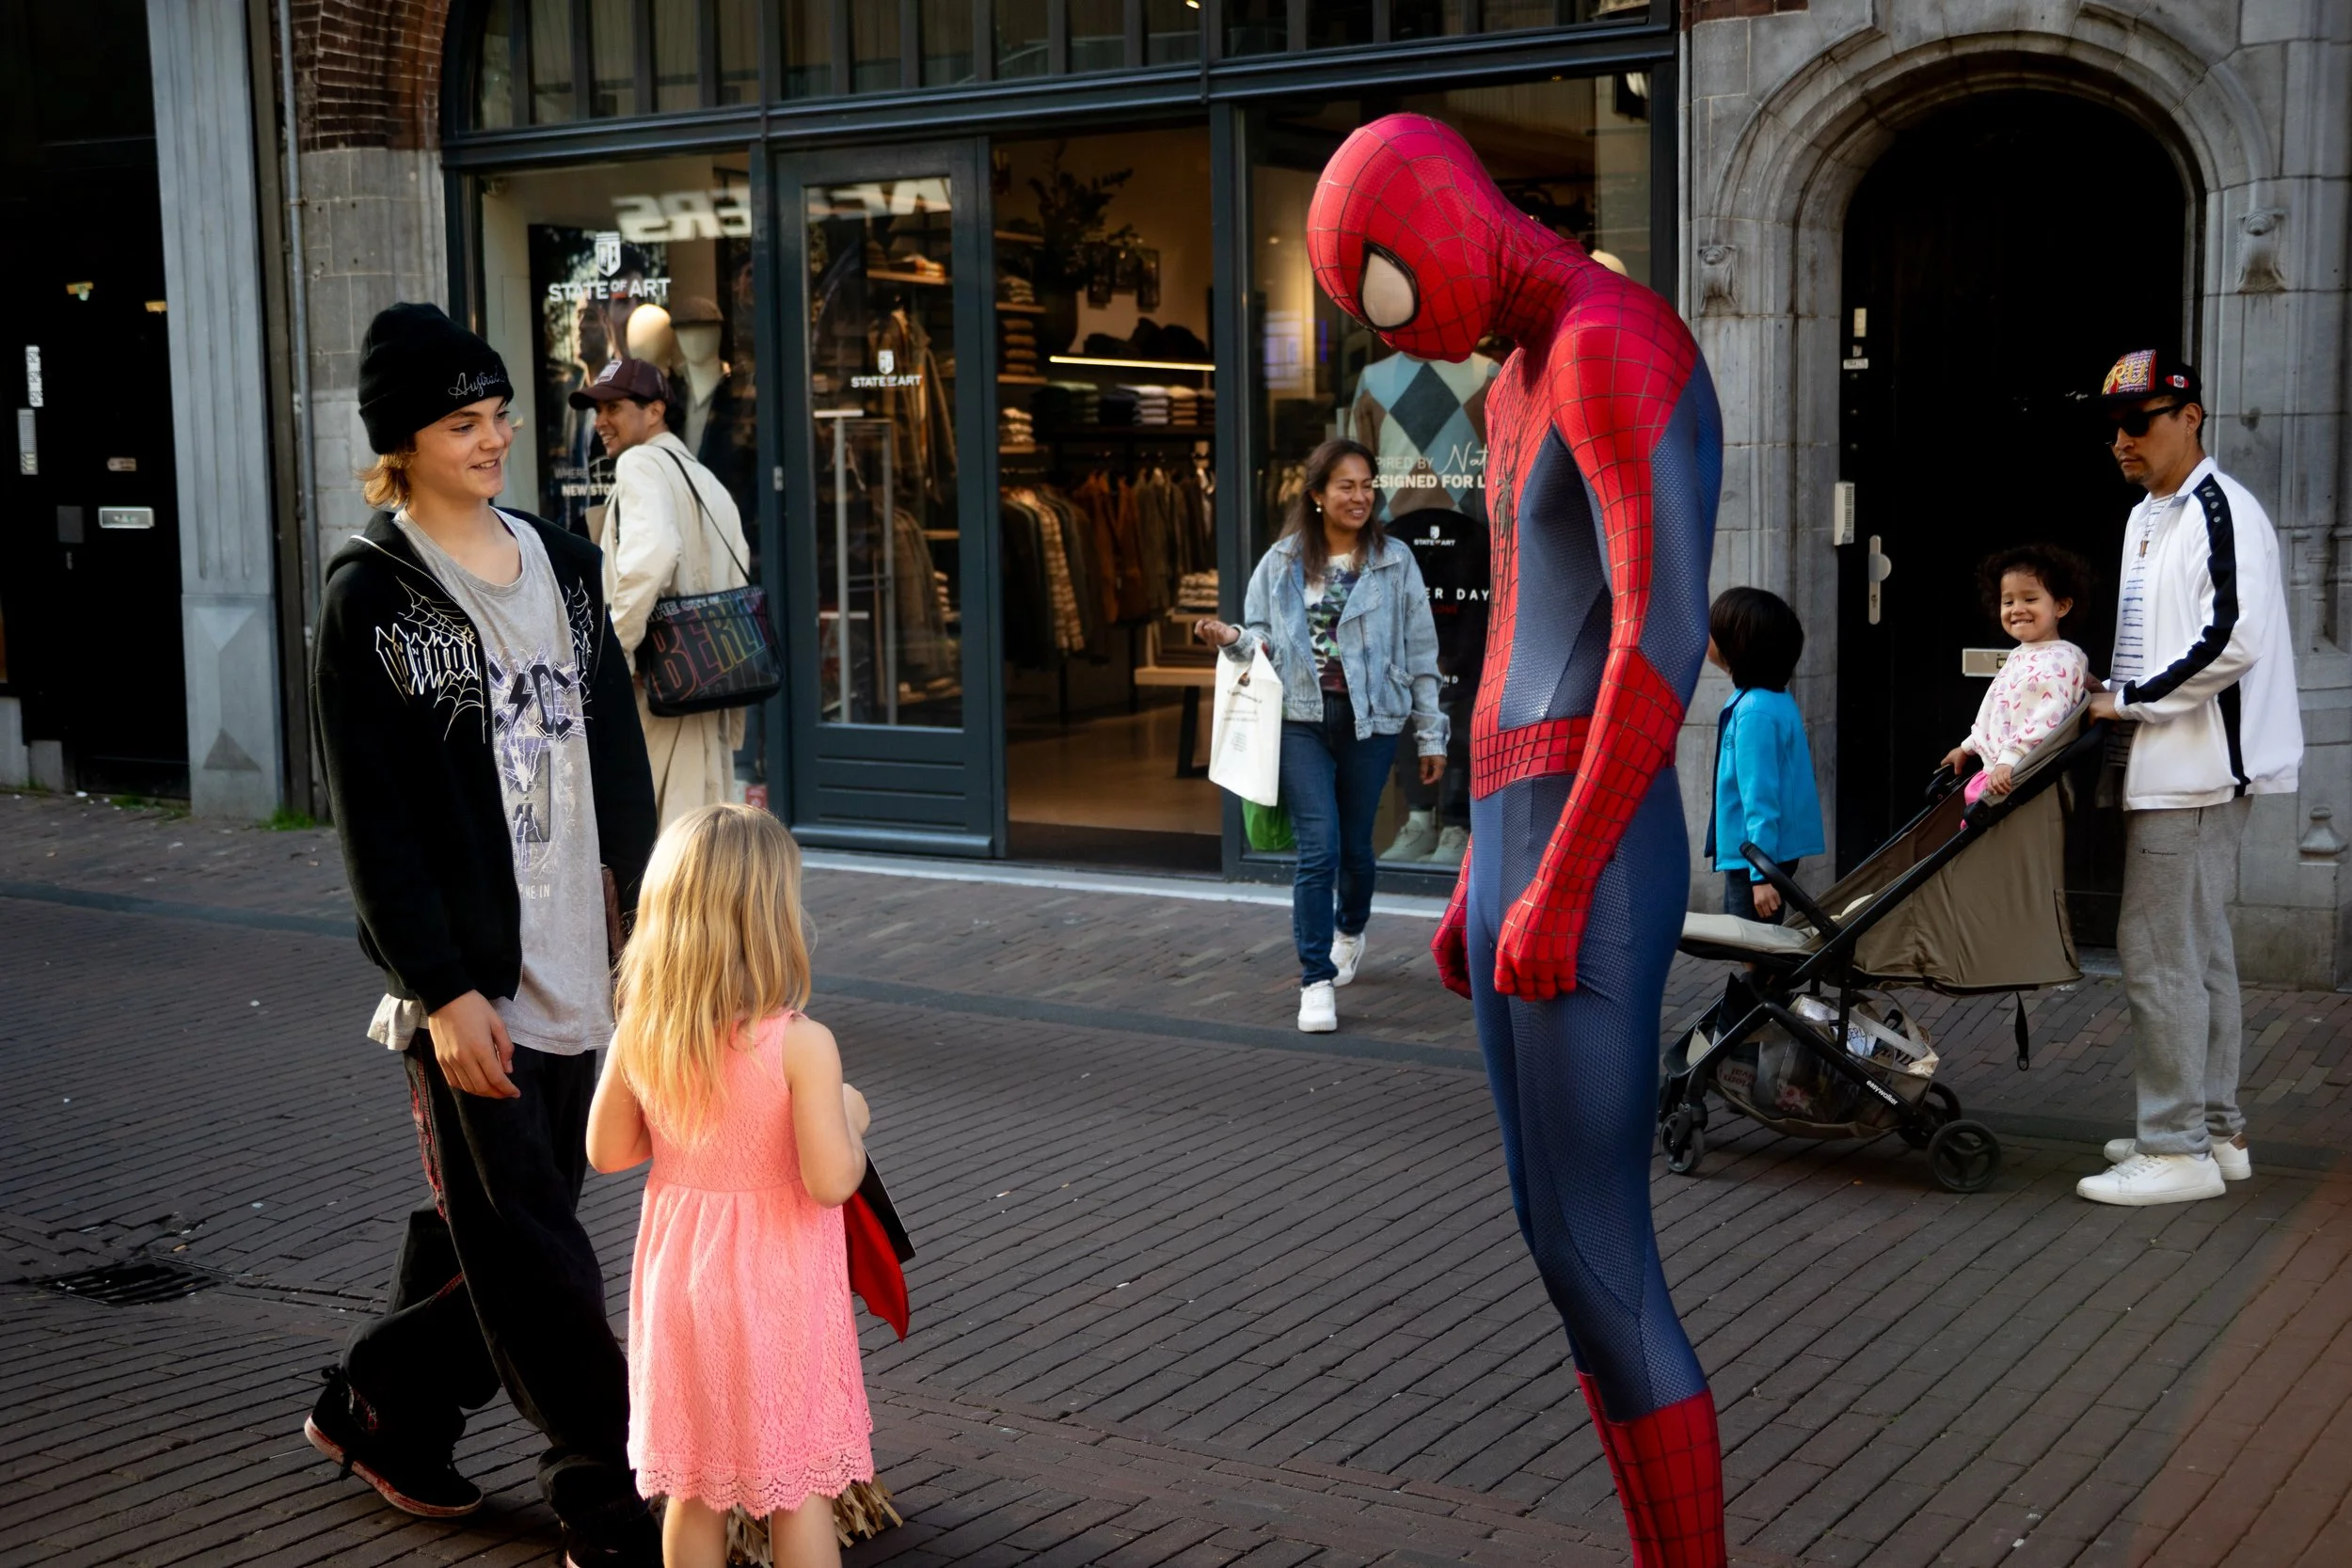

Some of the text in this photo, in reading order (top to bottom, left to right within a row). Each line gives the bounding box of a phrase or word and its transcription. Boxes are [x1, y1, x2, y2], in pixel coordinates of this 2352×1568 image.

[548, 277, 671, 302] STATE OF ART
[850, 376, 885, 388] STATE
[898, 374, 923, 386] ART
[1376, 440, 1489, 475] PIRED BY Nat
[562, 483, 613, 497] NEW STO
[1372, 473, 1438, 489] ESIGNED
[1441, 473, 1474, 489] FOR
[1866, 1080, 1899, 1106] easywalker
